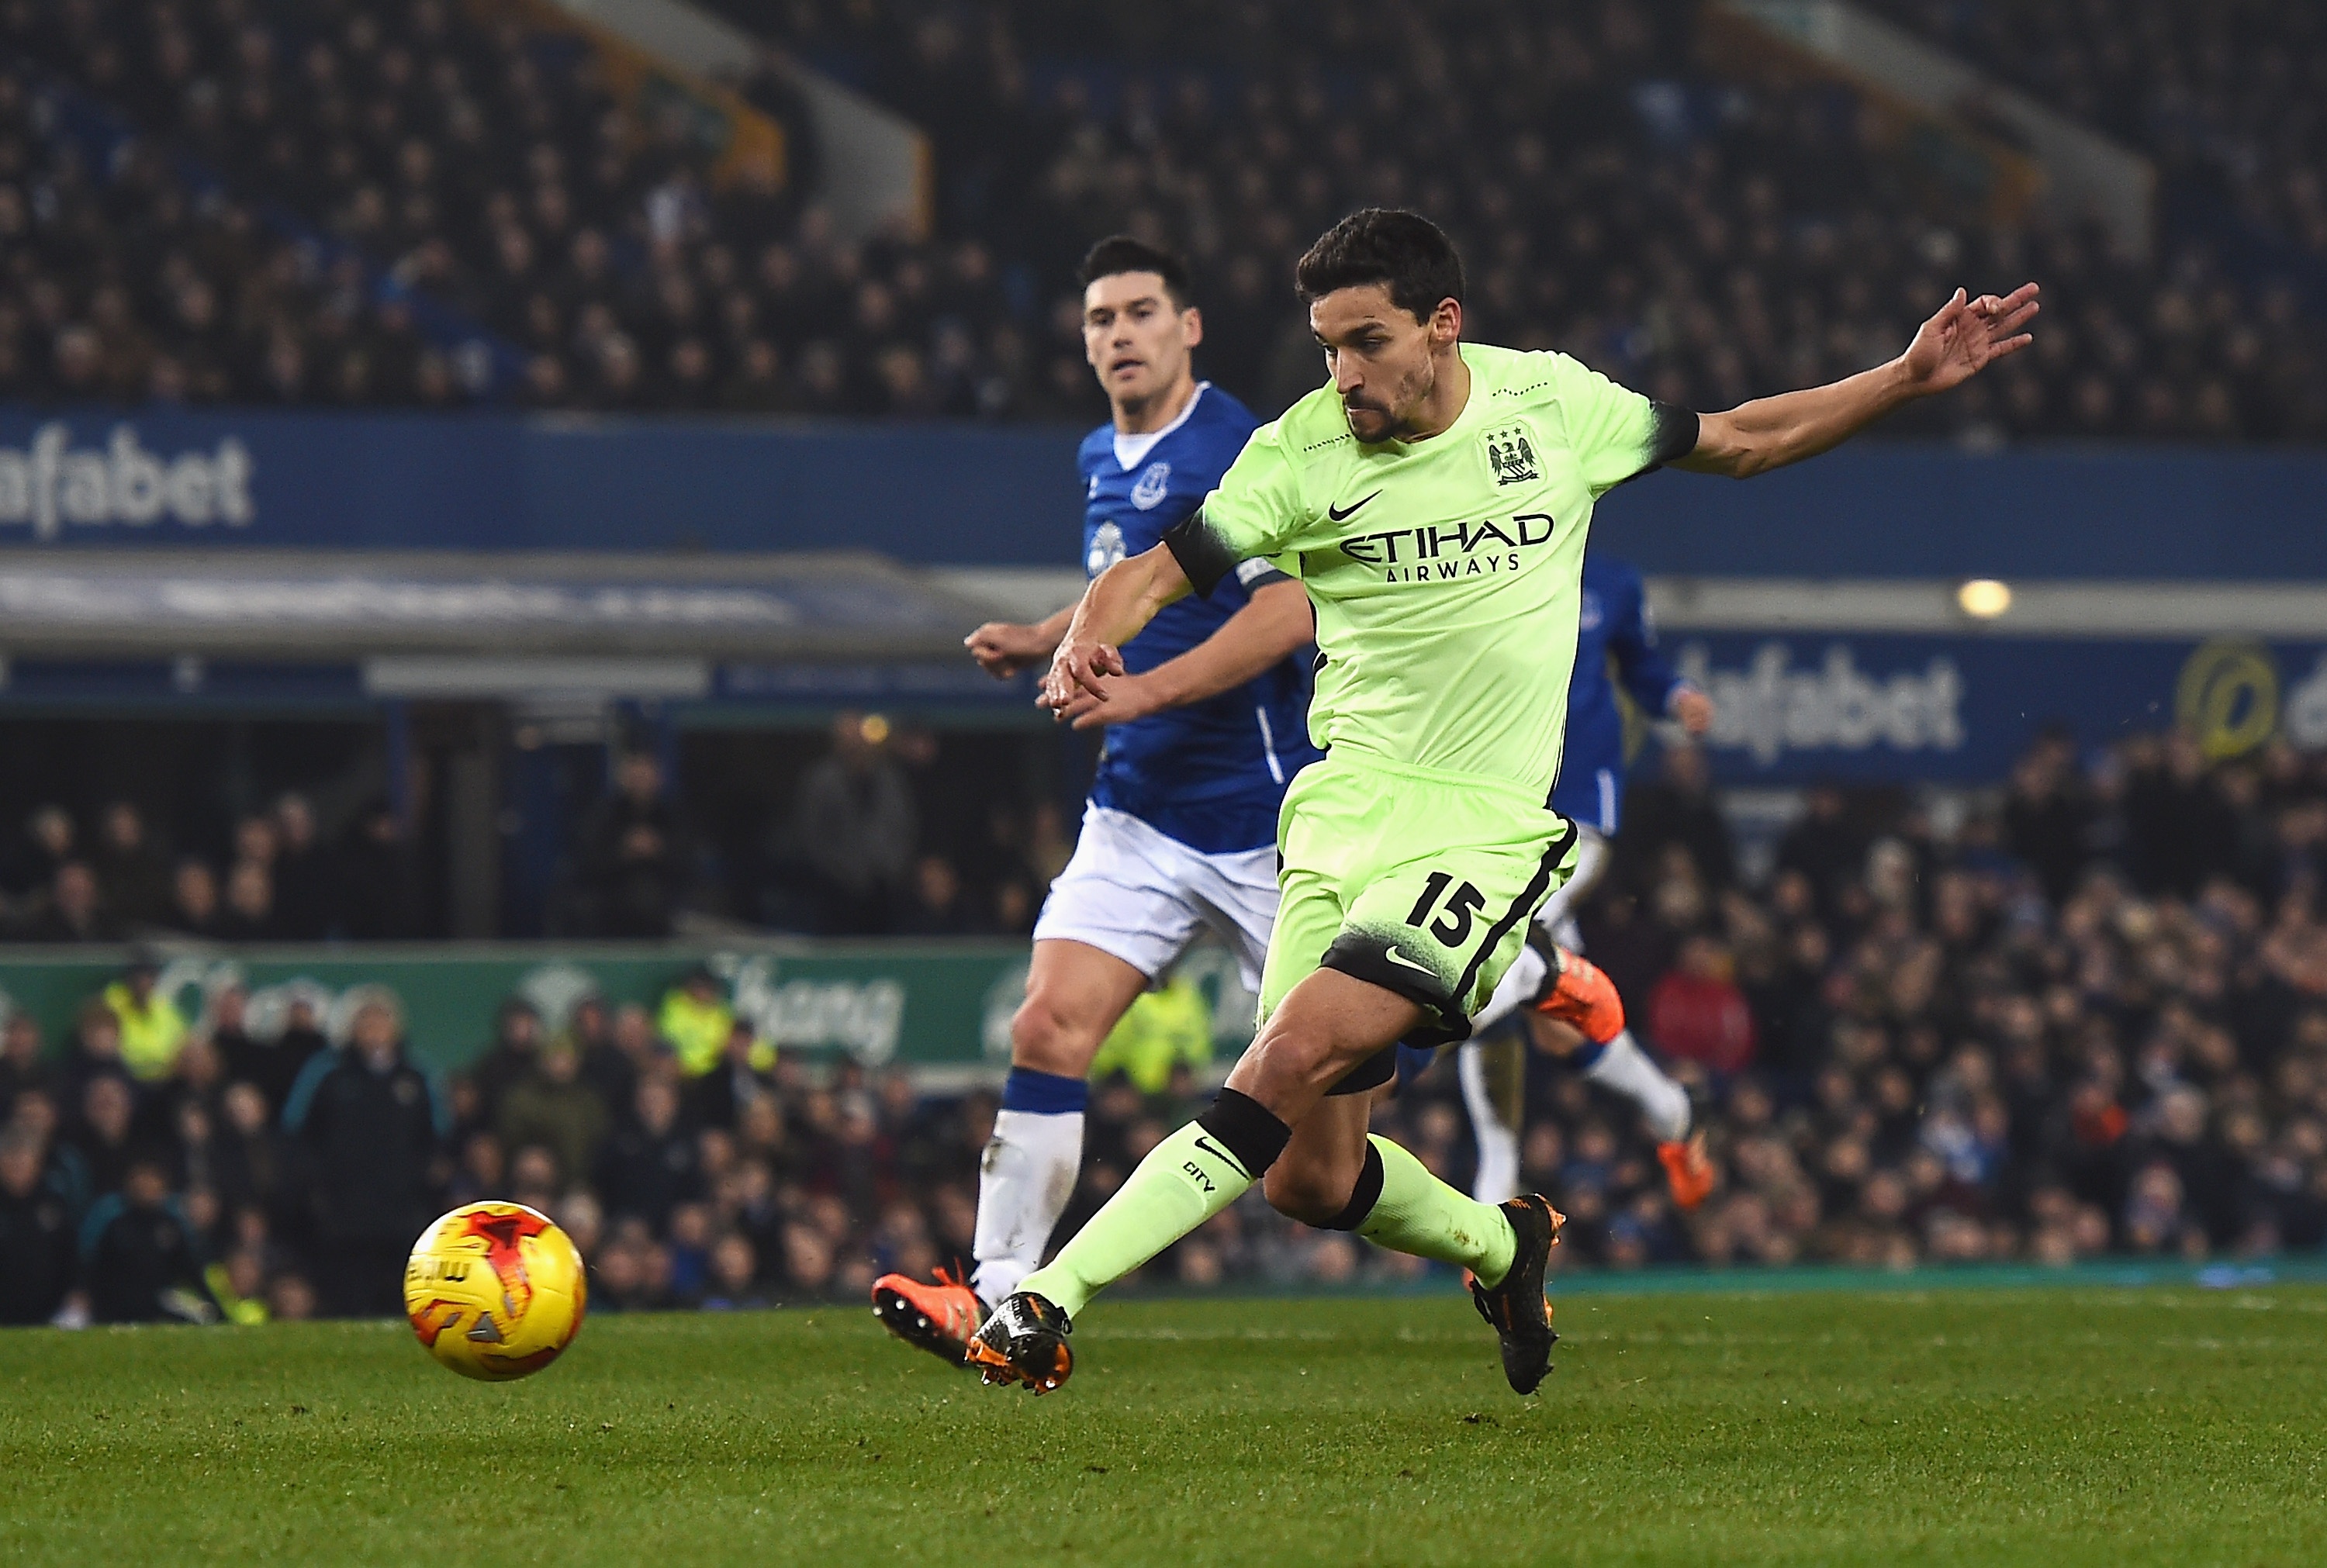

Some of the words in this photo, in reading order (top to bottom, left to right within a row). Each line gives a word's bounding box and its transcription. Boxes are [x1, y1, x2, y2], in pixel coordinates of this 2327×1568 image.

[1340, 513, 1554, 563] ETIHAD
[1386, 553, 1520, 582] AIRWAYS
[1406, 871, 1486, 948] 15
[1183, 1161, 1215, 1193] CITY
